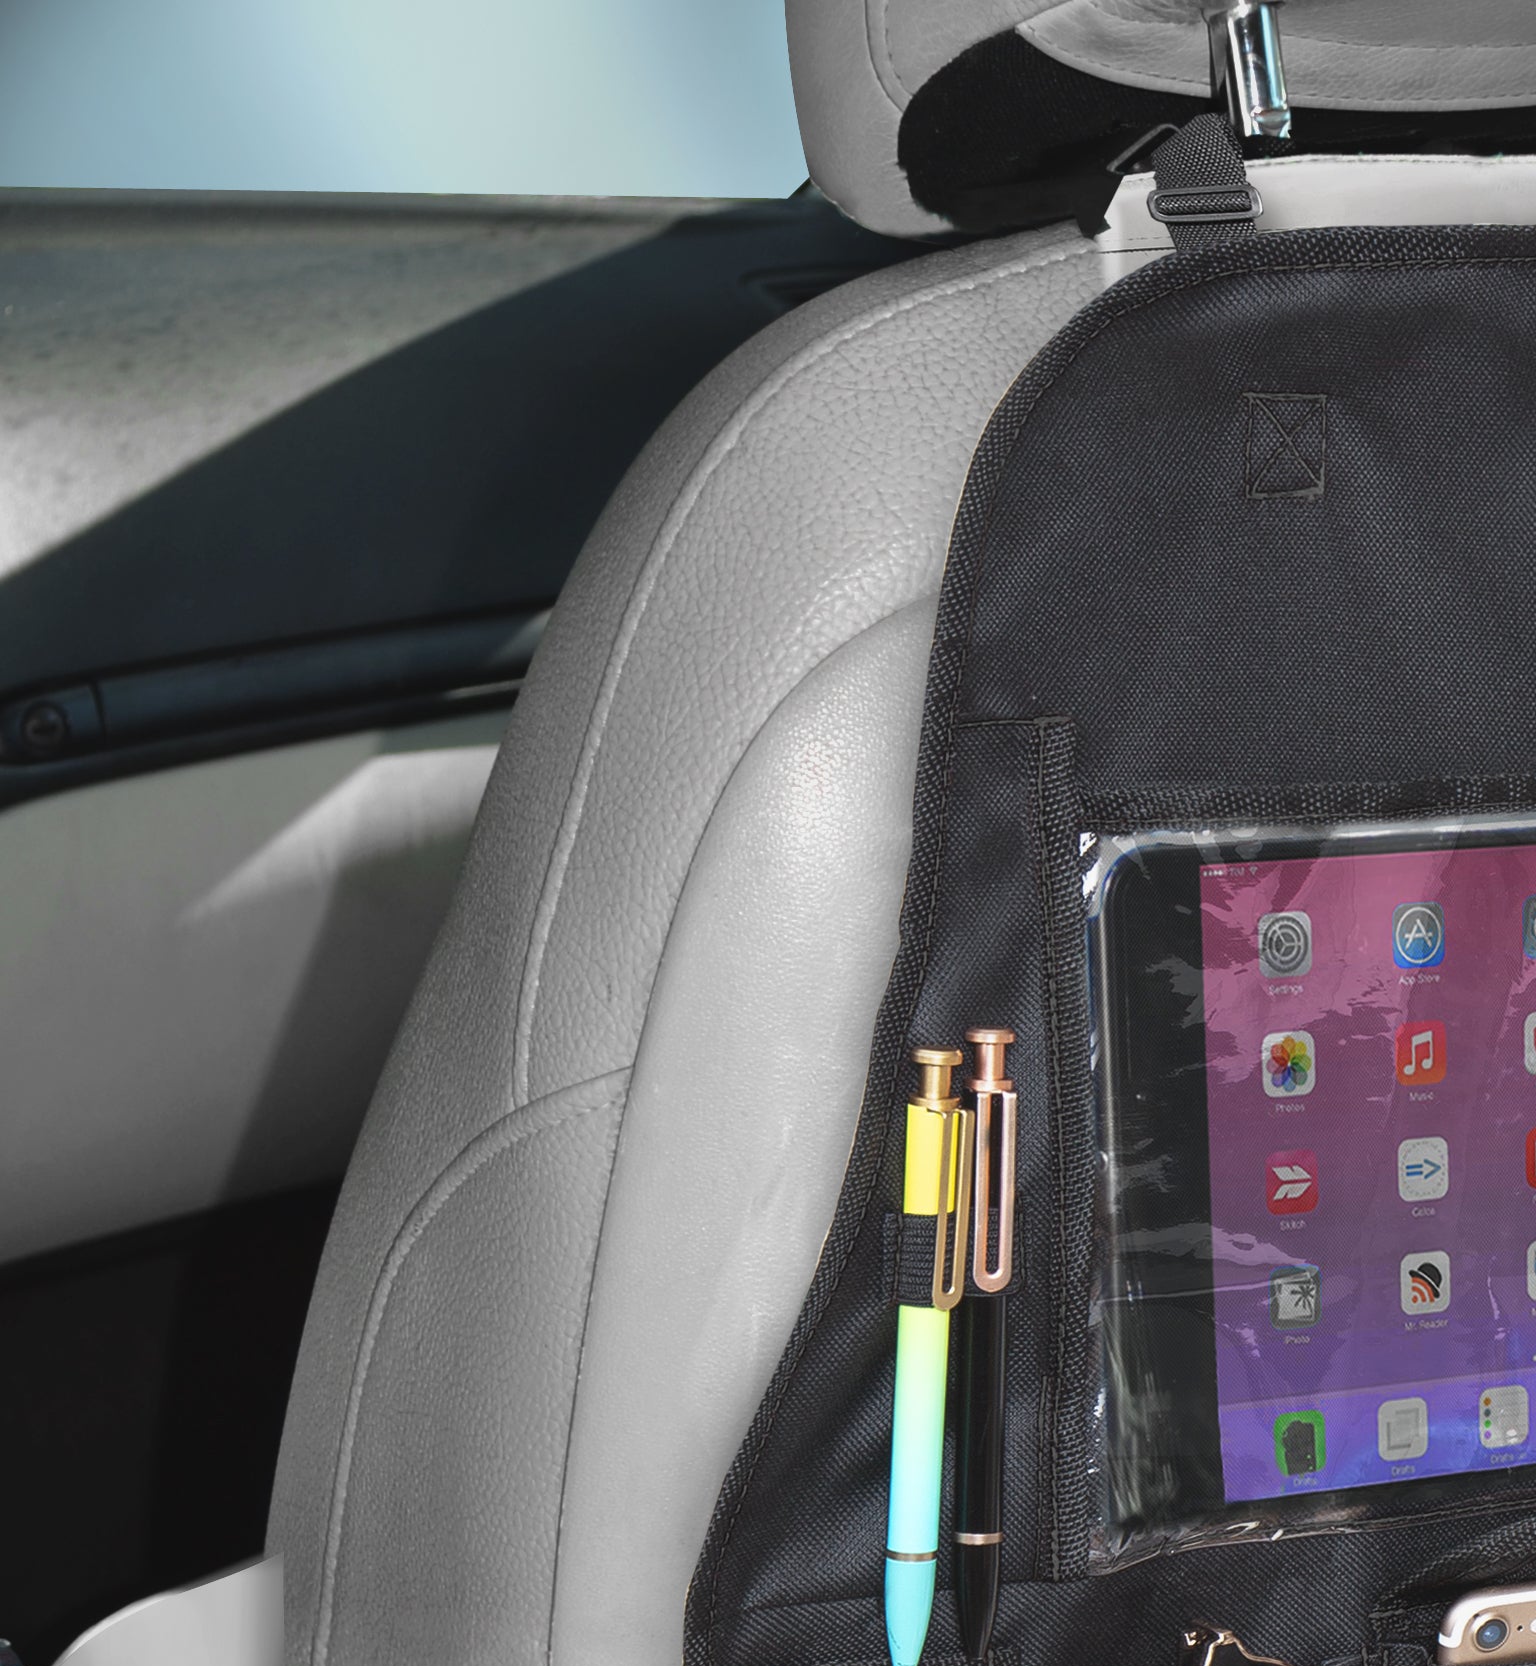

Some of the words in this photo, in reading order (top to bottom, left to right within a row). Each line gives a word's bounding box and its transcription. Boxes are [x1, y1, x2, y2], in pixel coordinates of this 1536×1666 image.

[1268, 984, 1303, 997] Settings
[1409, 1091, 1434, 1101] Music
[1275, 1102, 1305, 1113] Photos
